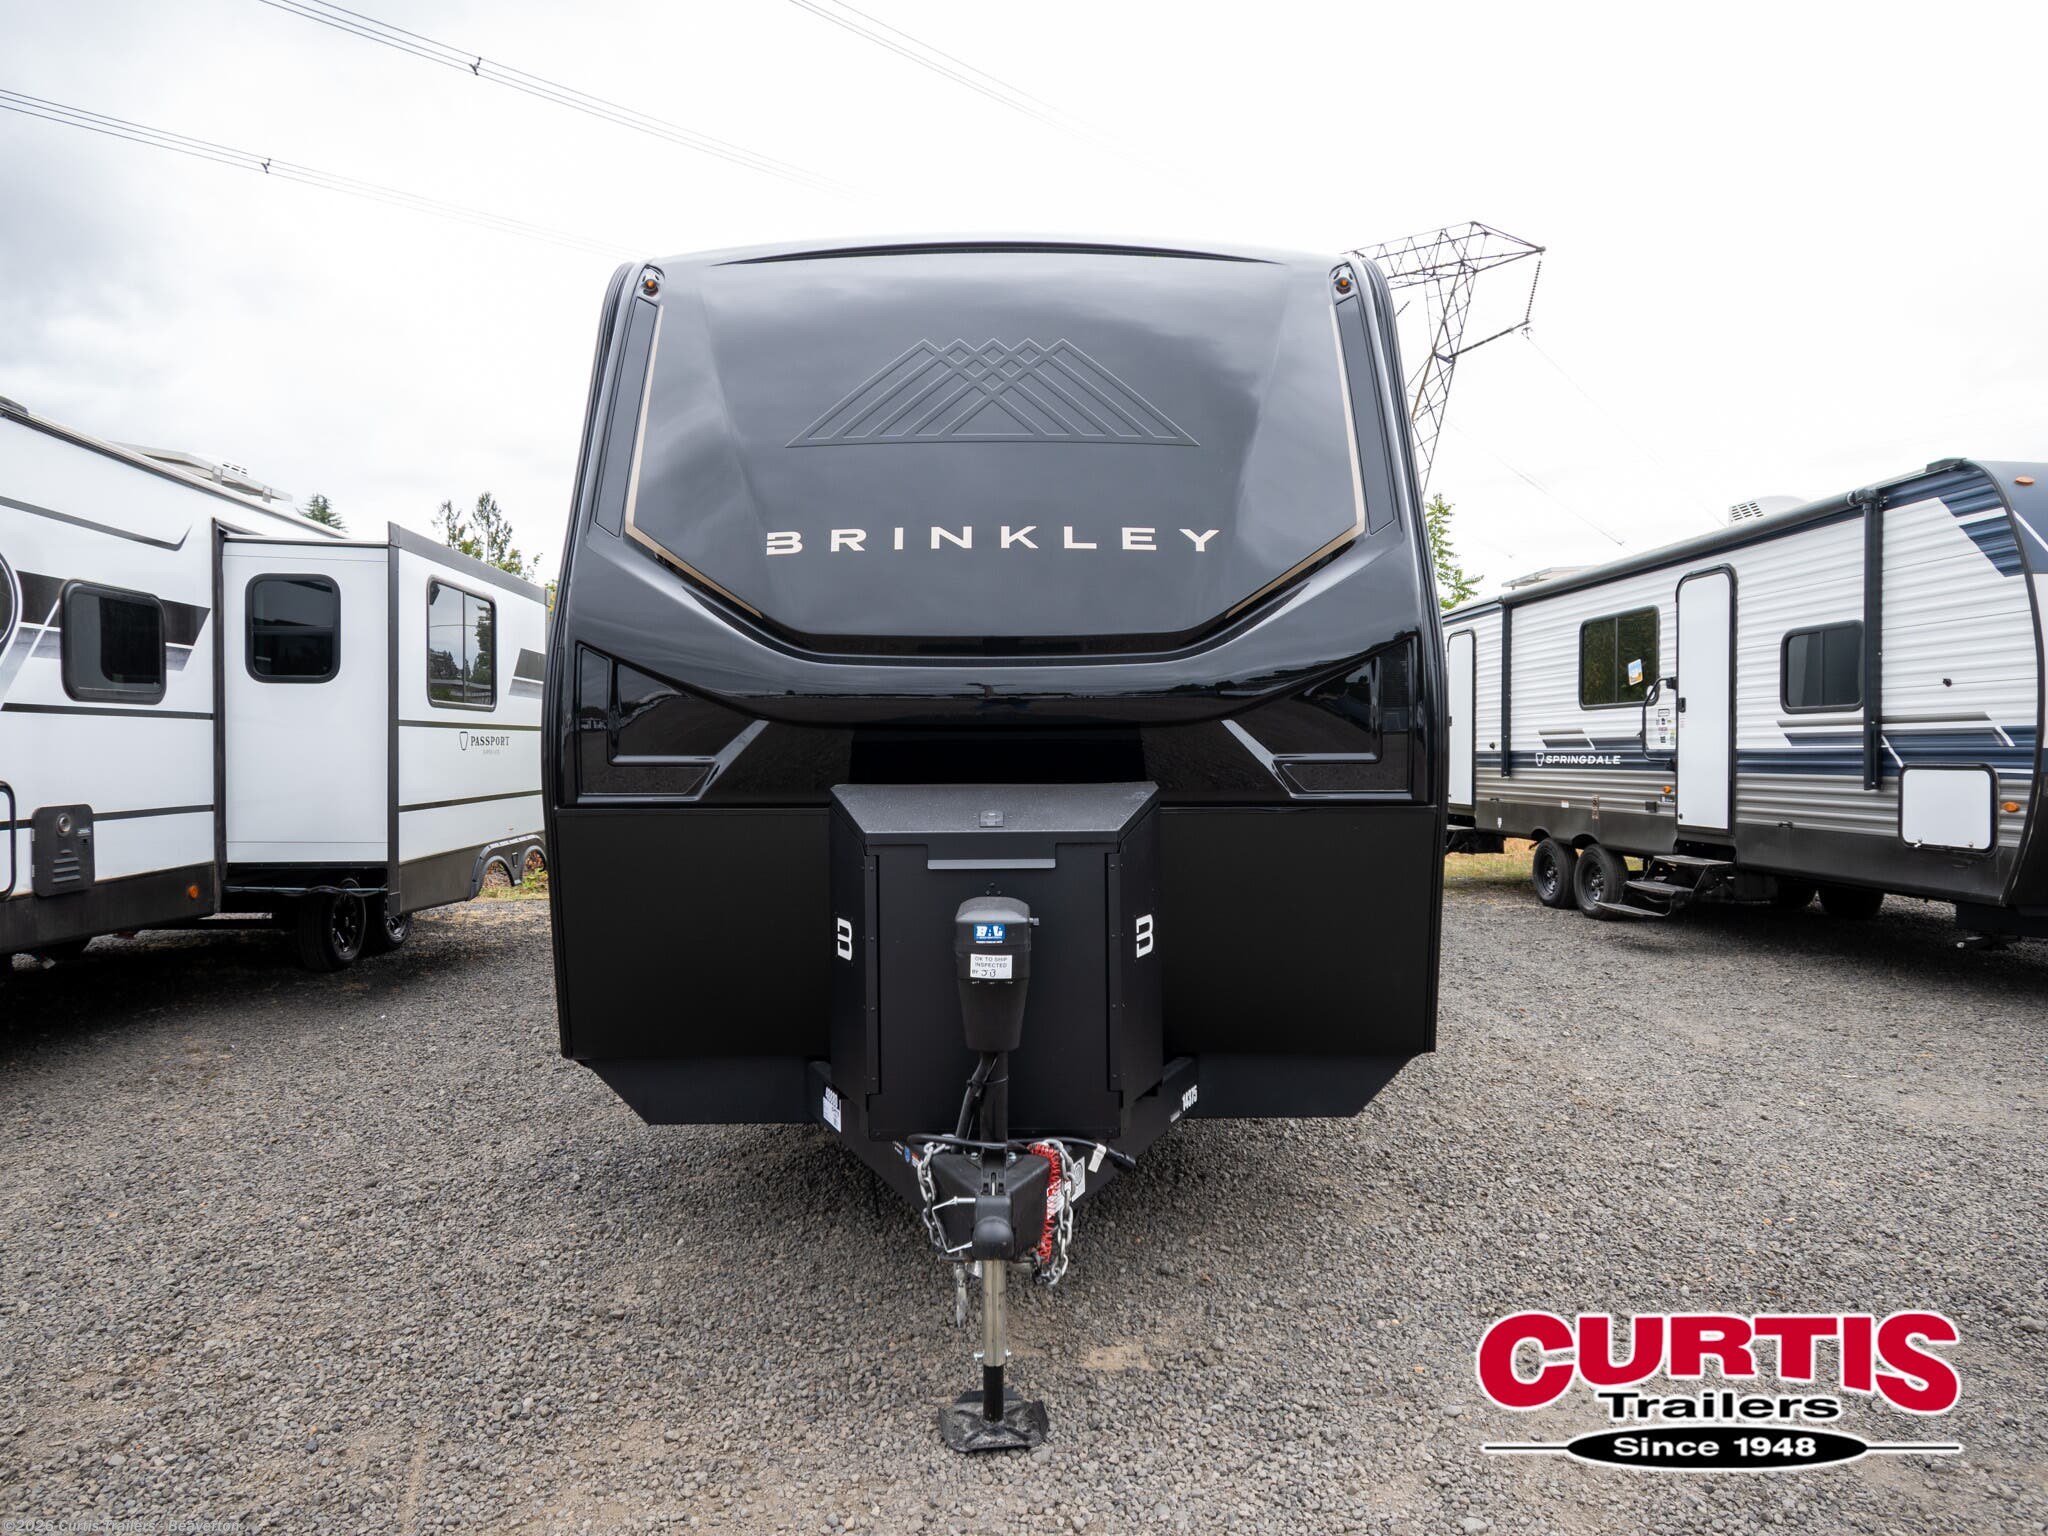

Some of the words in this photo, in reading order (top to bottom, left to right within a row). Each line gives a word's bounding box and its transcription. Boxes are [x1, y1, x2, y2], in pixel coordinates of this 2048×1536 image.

[766, 526, 1220, 555] BRINKLEY
[470, 736, 510, 746] PASSPORT
[1545, 755, 1621, 765] SPRINGDALE
